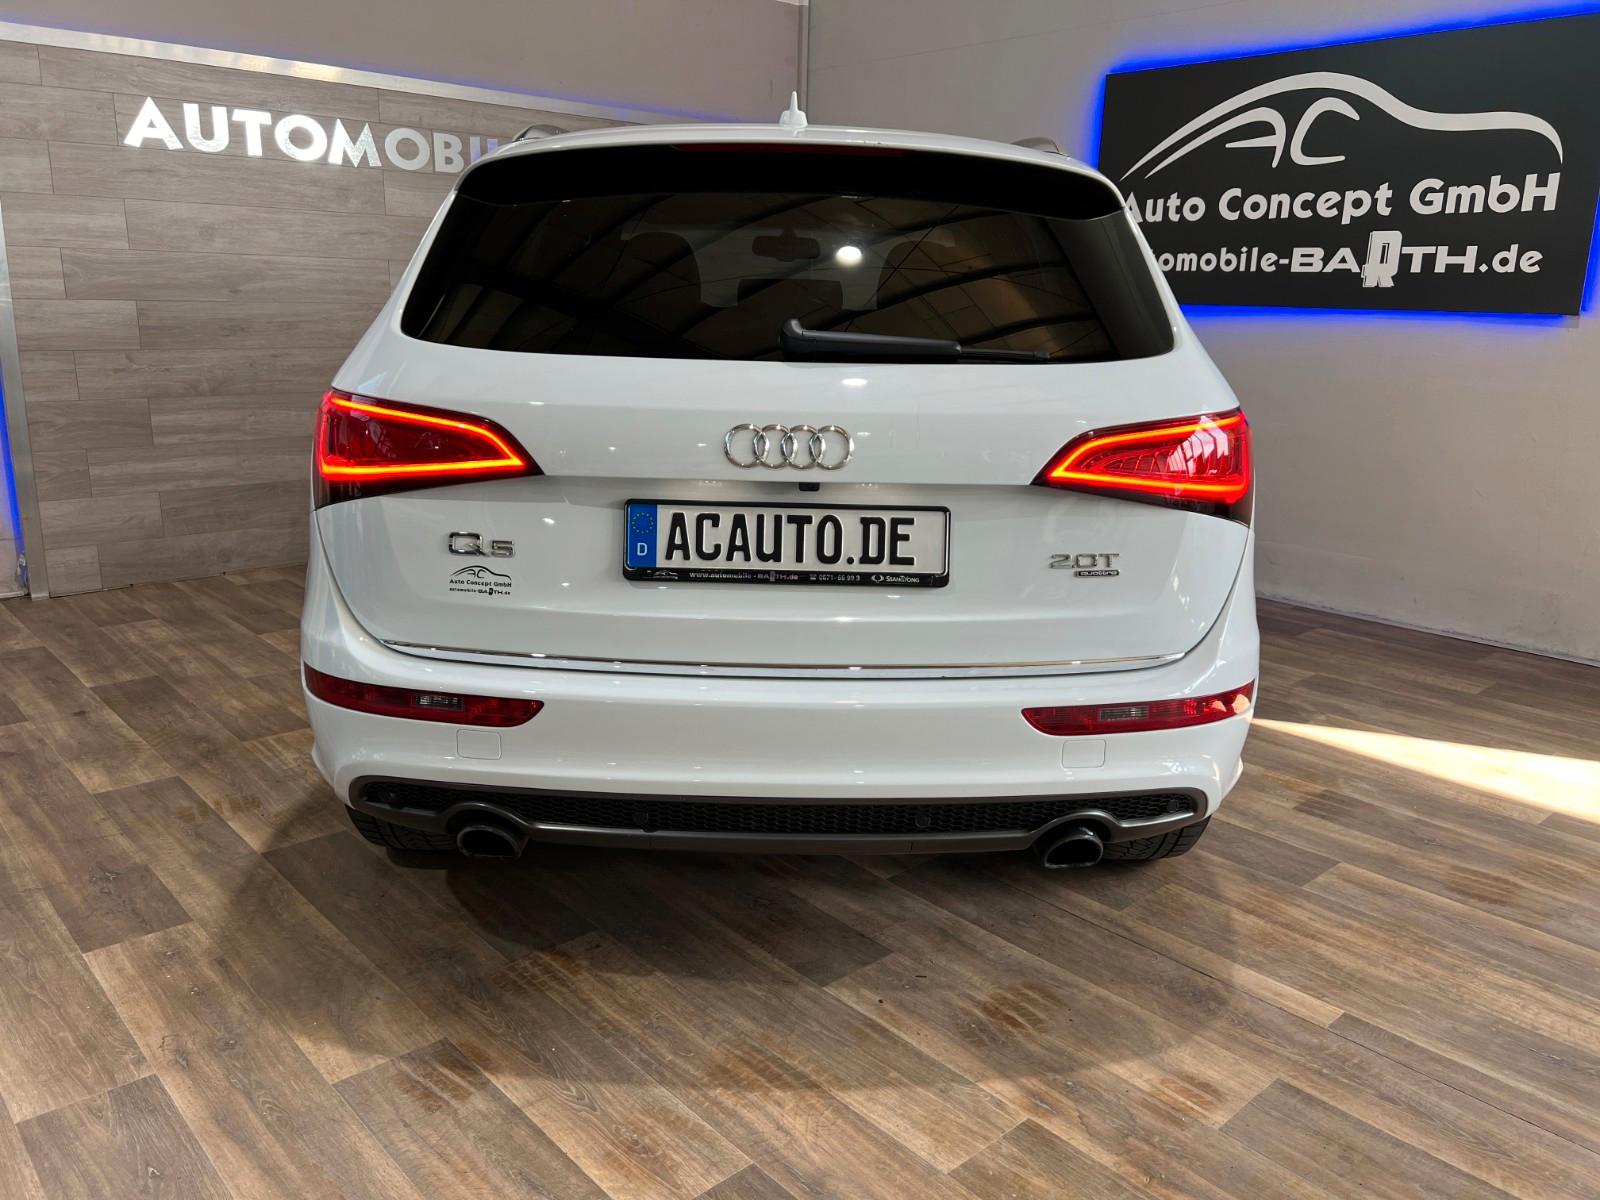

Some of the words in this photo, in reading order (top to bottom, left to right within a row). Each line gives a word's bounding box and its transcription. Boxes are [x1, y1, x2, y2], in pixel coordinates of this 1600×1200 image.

[1124, 191, 1206, 223] Auto
[1218, 182, 1393, 225] Concept
[1409, 172, 1561, 216] GmbH
[1152, 230, 1544, 288] omobile-BARTH.de
[448, 532, 514, 558] Q5
[636, 542, 648, 557] D
[664, 511, 916, 567] ACAUTO.DE
[1048, 553, 1120, 569] 2.0T
